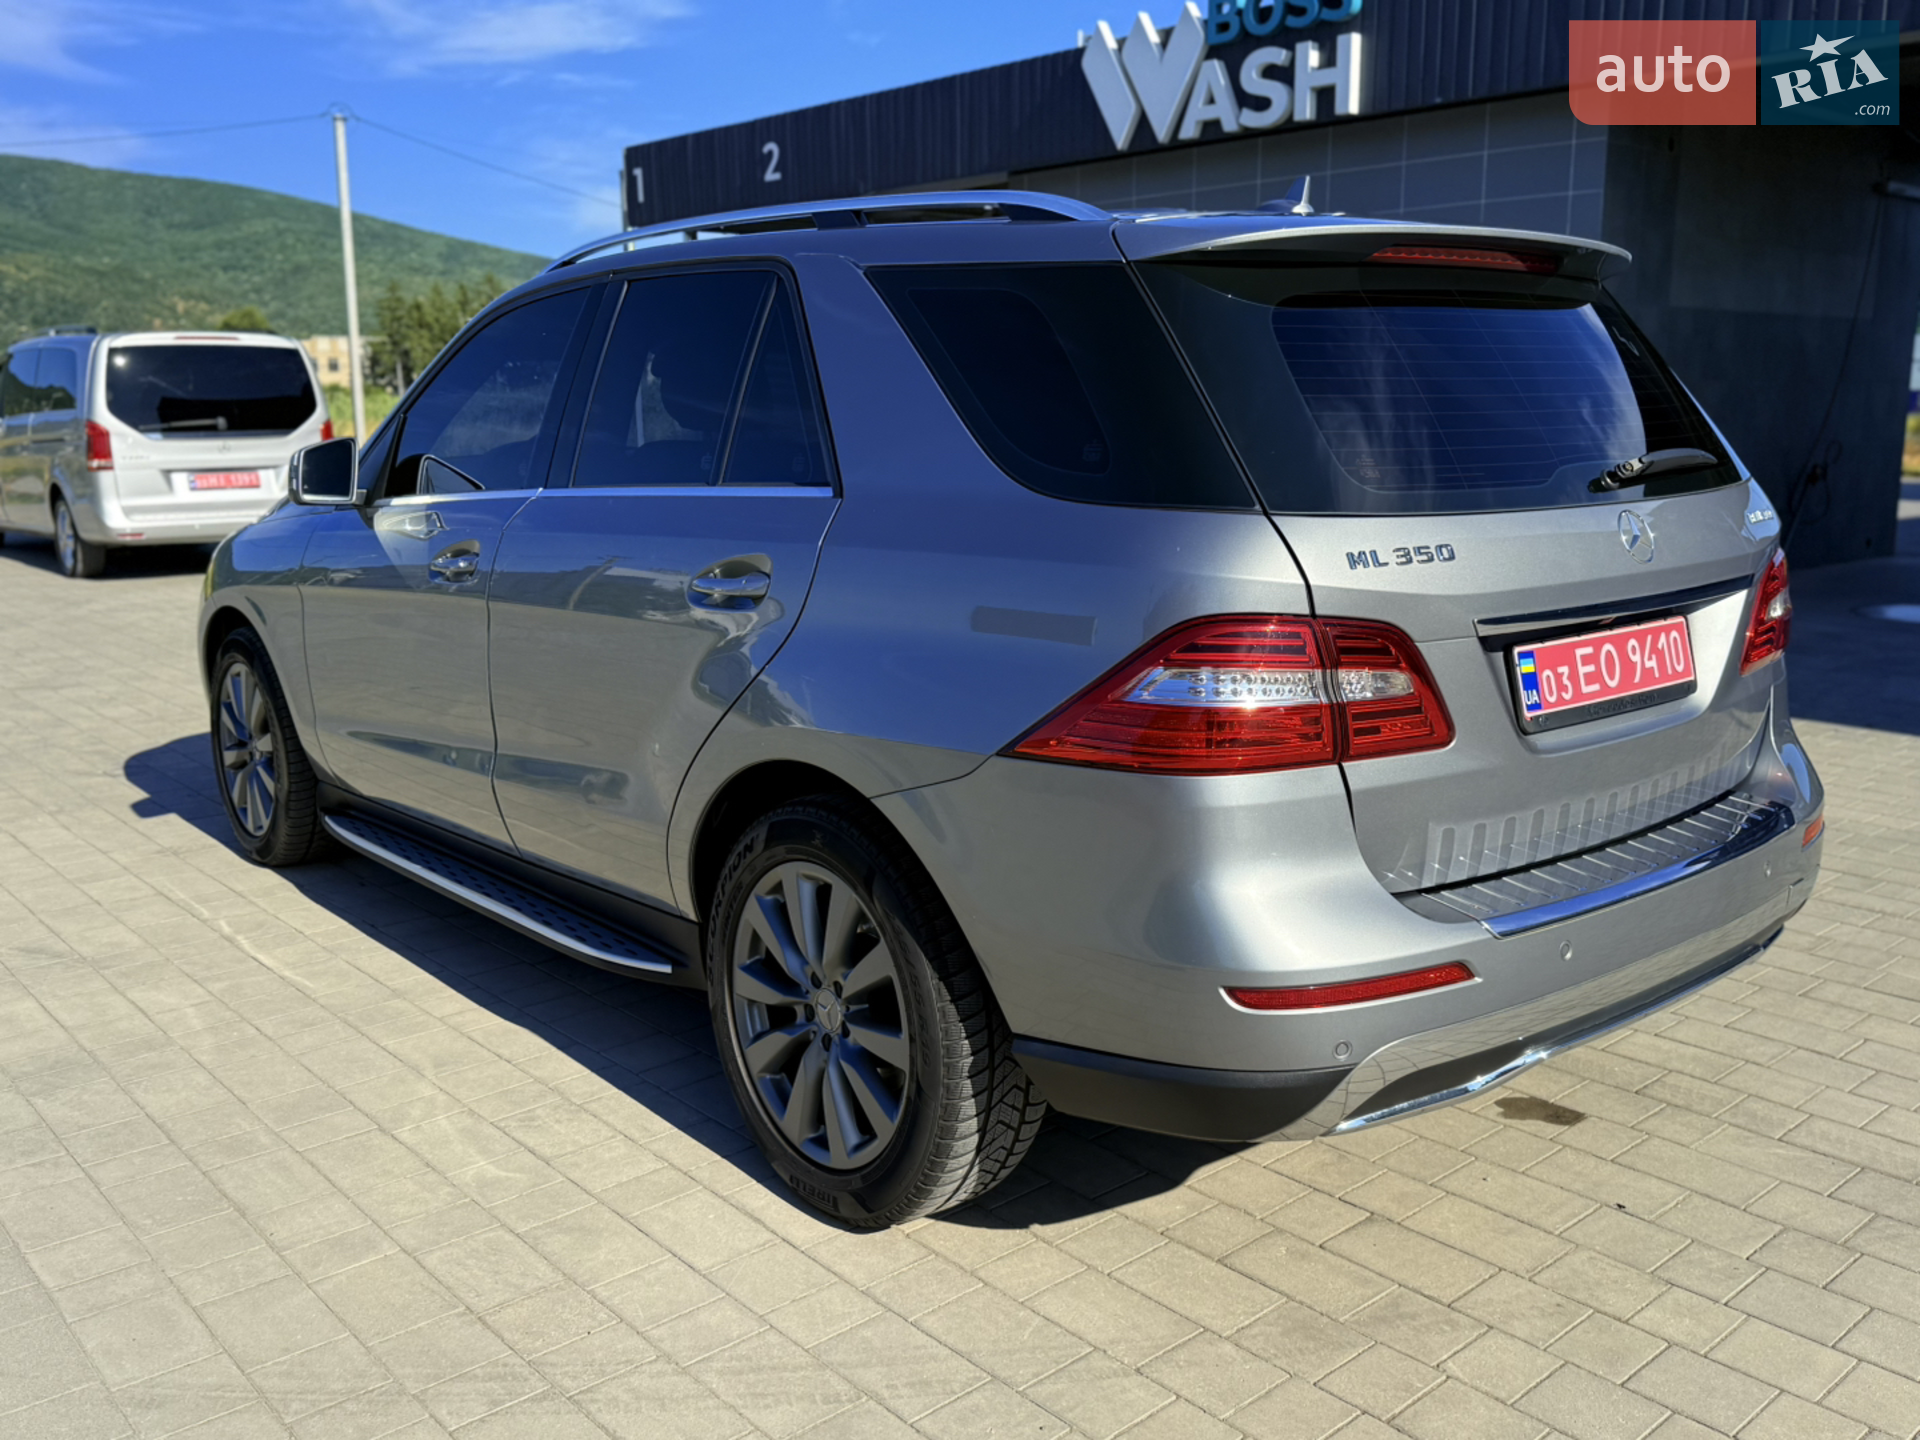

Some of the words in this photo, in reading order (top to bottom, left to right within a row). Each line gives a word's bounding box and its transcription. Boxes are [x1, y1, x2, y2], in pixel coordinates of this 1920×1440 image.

[1081, 1, 1362, 152] WASH
[762, 141, 782, 182] 2
[632, 167, 645, 204] 1
[1345, 549, 1390, 570] ML
[1392, 543, 1456, 566] 350
[1541, 665, 1573, 704] 03
[1574, 642, 1621, 694] EO
[1626, 629, 1685, 684] 9410
[1523, 689, 1541, 705] UA
